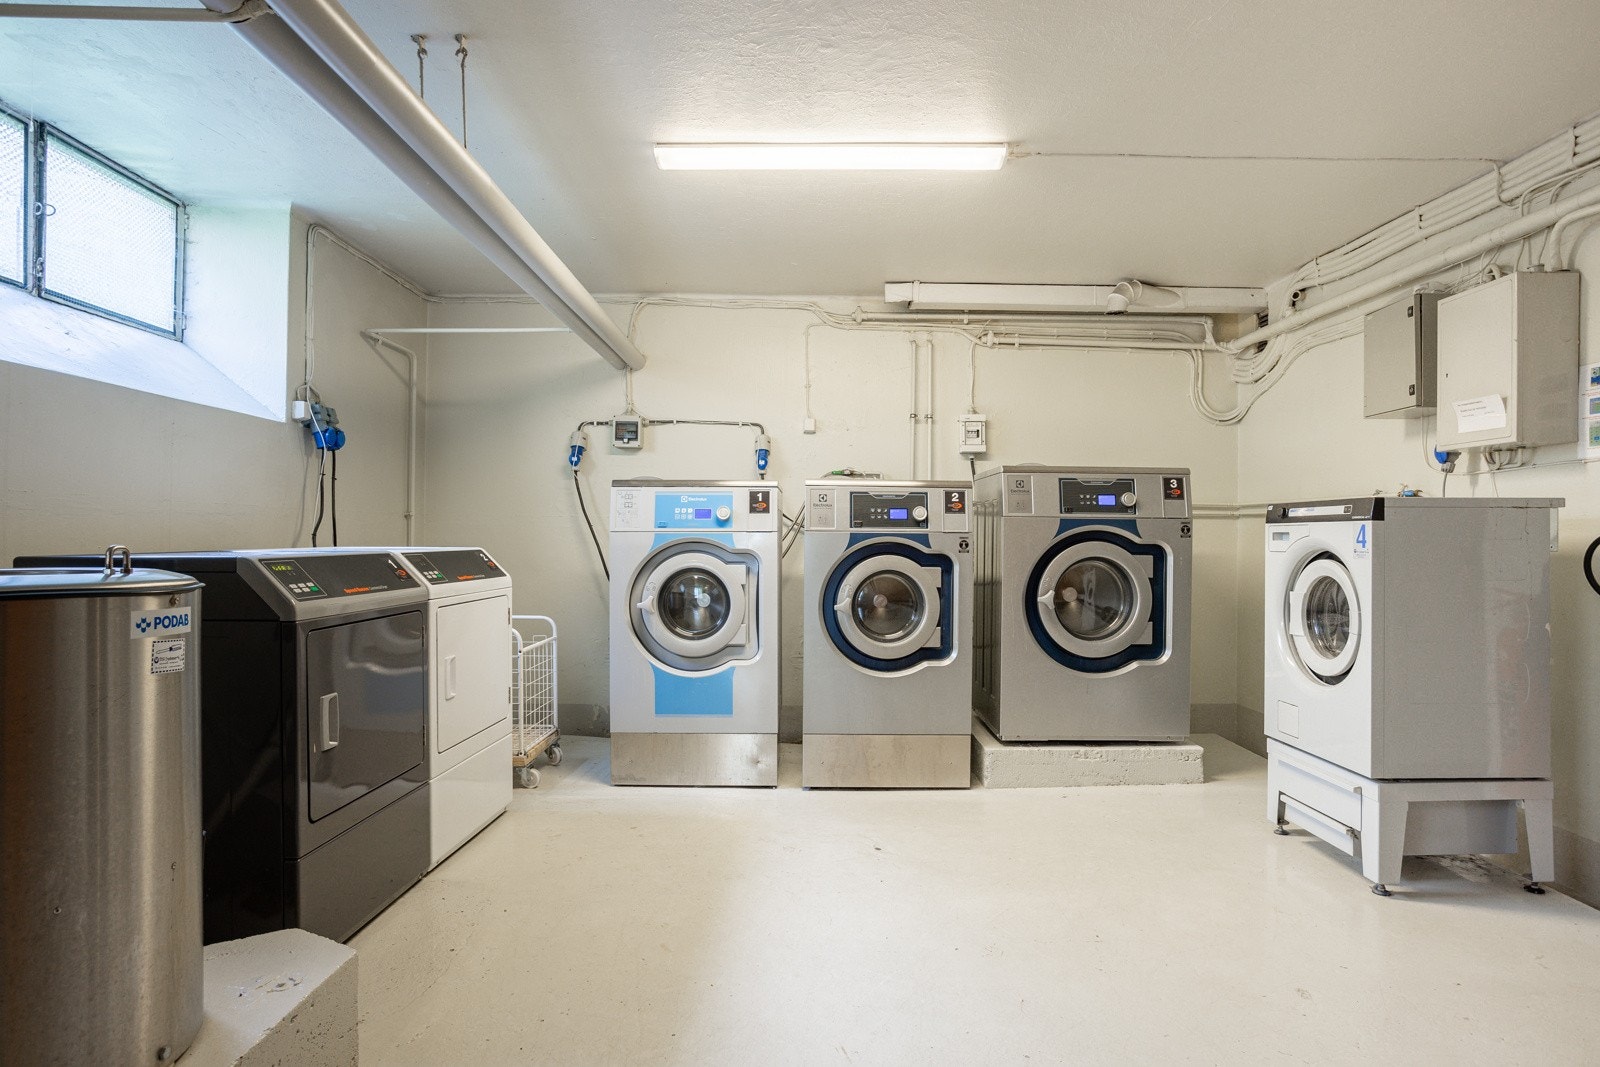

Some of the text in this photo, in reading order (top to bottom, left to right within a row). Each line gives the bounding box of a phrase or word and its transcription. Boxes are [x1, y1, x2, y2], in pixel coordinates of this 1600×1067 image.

[1170, 479, 1178, 488] 3
[756, 492, 763, 502] 1
[951, 492, 959, 502] 2
[1356, 523, 1367, 549] 4
[479, 553, 489, 561] 2
[388, 559, 398, 569] 1
[153, 613, 189, 629] PODAB
